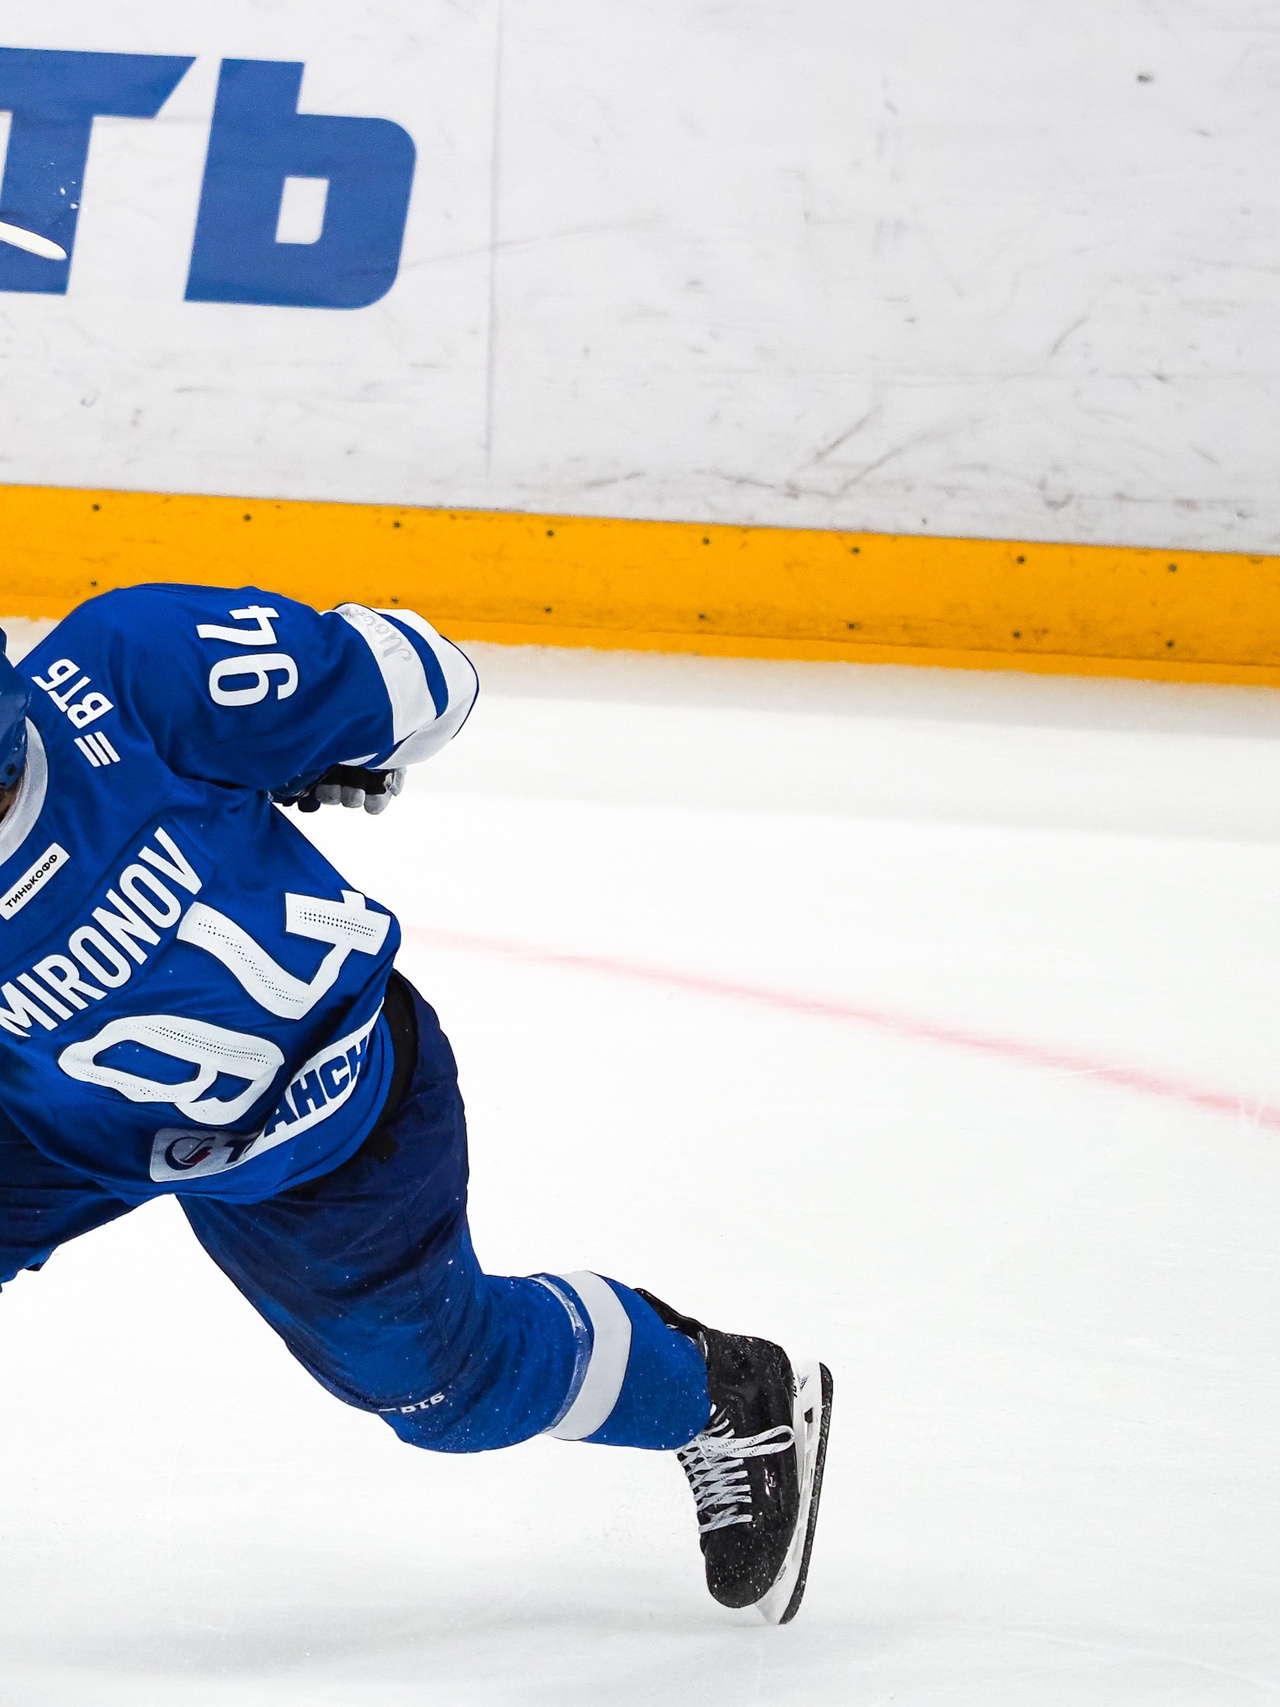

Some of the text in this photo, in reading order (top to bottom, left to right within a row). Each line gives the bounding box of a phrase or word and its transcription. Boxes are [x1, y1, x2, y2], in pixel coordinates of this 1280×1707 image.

[31, 658, 114, 729] ВТБ
[197, 604, 299, 707] 94
[4, 852, 59, 910] ТИНЬКОФФ
[58, 889, 391, 1126] 94
